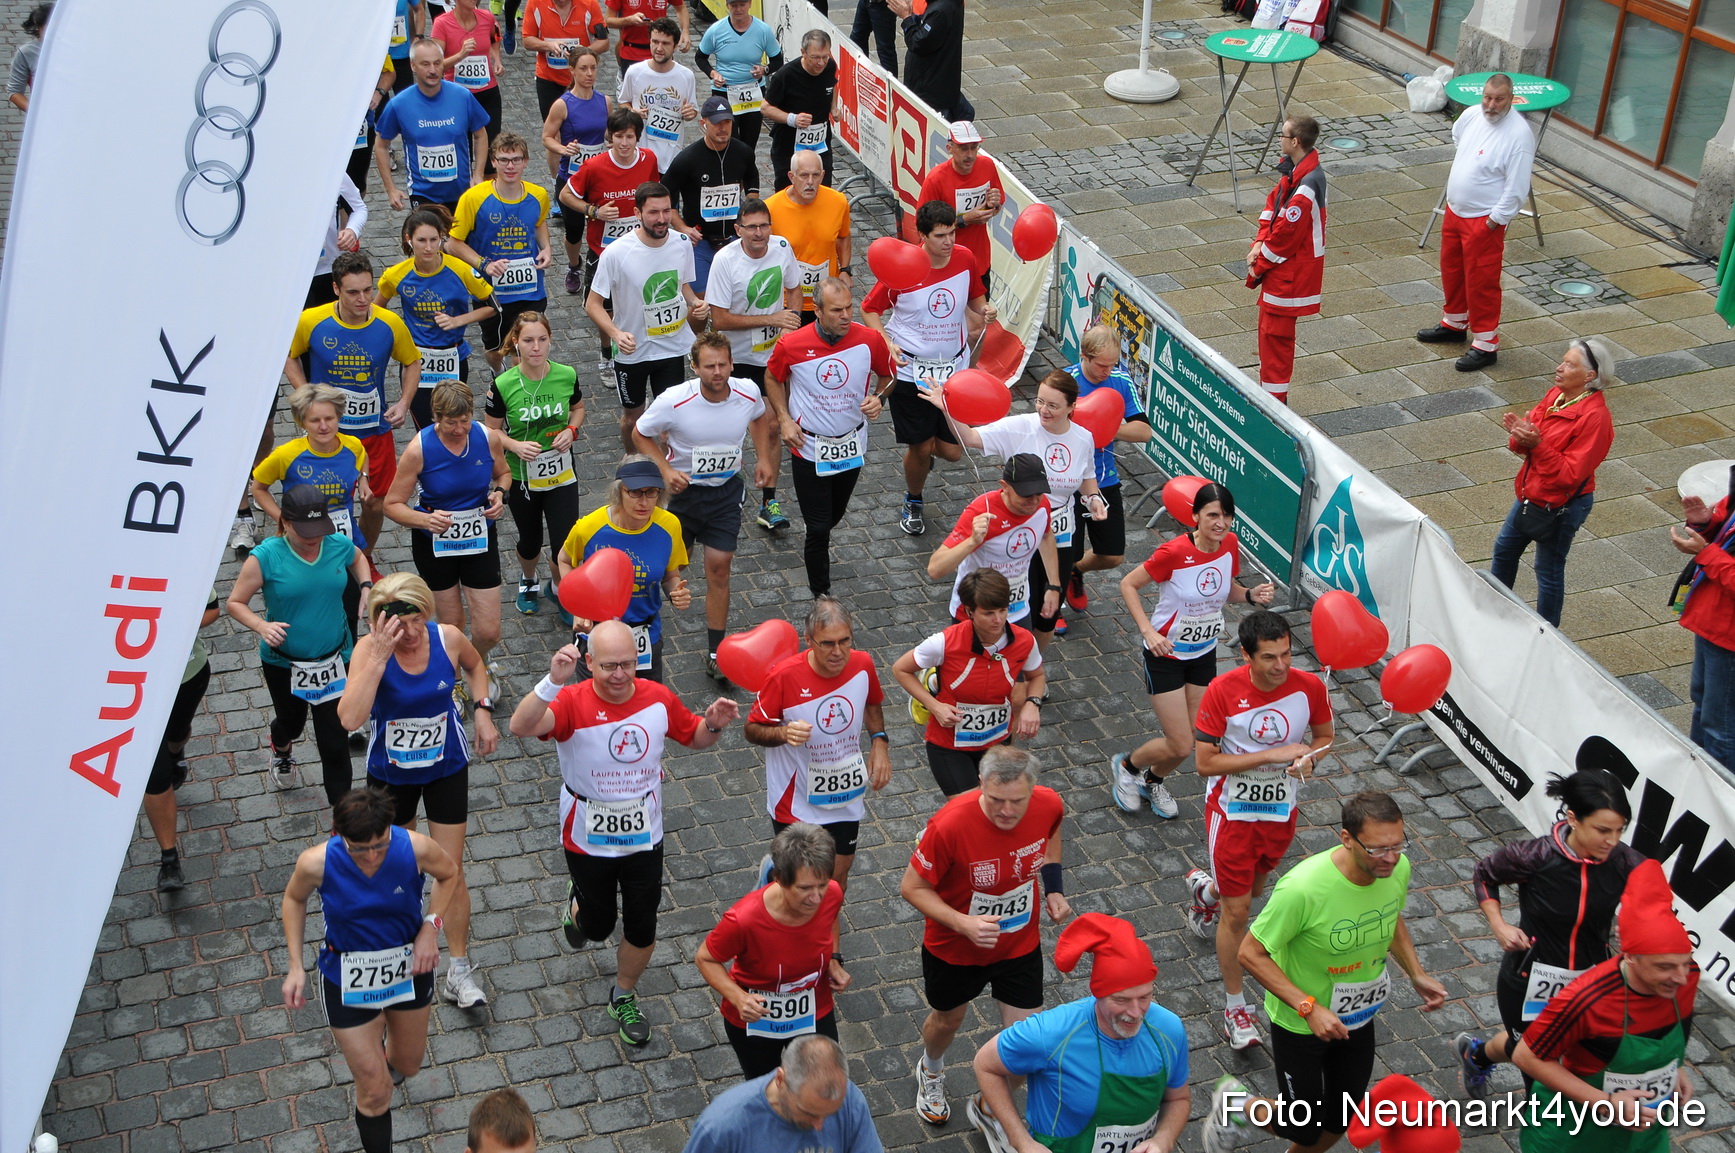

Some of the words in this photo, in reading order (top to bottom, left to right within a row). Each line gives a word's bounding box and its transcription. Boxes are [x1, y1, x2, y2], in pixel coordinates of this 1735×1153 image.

[458, 64, 487, 77] 2883
[644, 95, 655, 105] 10
[739, 90, 753, 102] 43
[418, 116, 454, 128] Sinupret
[650, 114, 682, 132] 2527
[799, 129, 826, 144] 2947
[421, 153, 454, 169] 2709
[603, 189, 636, 200] NEUMAR
[705, 192, 737, 208] 2757
[497, 268, 533, 285] 2808
[803, 273, 820, 285] 34
[654, 305, 681, 326] 137
[660, 324, 679, 334] Stefan
[420, 358, 455, 372] 2480
[918, 365, 954, 380] 2172
[1177, 359, 1245, 426] Event-Leit-Systeme
[346, 400, 376, 416] 591
[518, 402, 564, 422] 2014
[1155, 381, 1185, 420] Mehr
[1187, 408, 1246, 476] Sicherheit
[820, 440, 858, 461] 2939
[1152, 405, 1170, 434] für
[1171, 422, 1188, 450] Ihr
[1190, 439, 1228, 488] Event!
[1150, 441, 1167, 464] Miet
[1166, 457, 1173, 471] &
[537, 457, 564, 477] 251
[696, 456, 737, 473] 2347
[830, 462, 851, 470] Martin
[547, 478, 560, 486] Eva
[1050, 516, 1069, 533] 30
[443, 540, 478, 550] Hildegard
[1241, 526, 1259, 551] 6352
[69, 575, 169, 798] Audi
[123, 327, 216, 534] BKK
[1009, 584, 1025, 603] 58
[1179, 623, 1221, 642] 2846
[296, 662, 339, 688] 2491
[410, 720, 440, 728] Neumarkt
[961, 708, 1008, 731] 2348
[392, 725, 442, 749] 2722
[405, 752, 428, 761] Luise
[1455, 717, 1468, 739] die
[1469, 733, 1519, 789] verbinden
[830, 762, 857, 773] Neumarkt
[814, 768, 864, 793] 2835
[827, 793, 850, 803] Josef
[1234, 782, 1287, 802] 2866
[609, 804, 639, 813] Neumarkt
[1238, 804, 1277, 813] Johannes
[592, 811, 645, 833] 2863
[975, 874, 995, 883] NEU
[342, 956, 368, 965] PARTL
[368, 952, 402, 964] Neumarkt
[349, 960, 407, 988] 2754
[1327, 961, 1362, 975] MERZ
[1533, 969, 1558, 980] PARTL
[363, 989, 395, 1002] Christa
[1336, 984, 1387, 1015] 2245
[769, 1022, 794, 1032] Lydia
[1613, 1076, 1672, 1101] 53
[1096, 1131, 1122, 1139] PARTL
